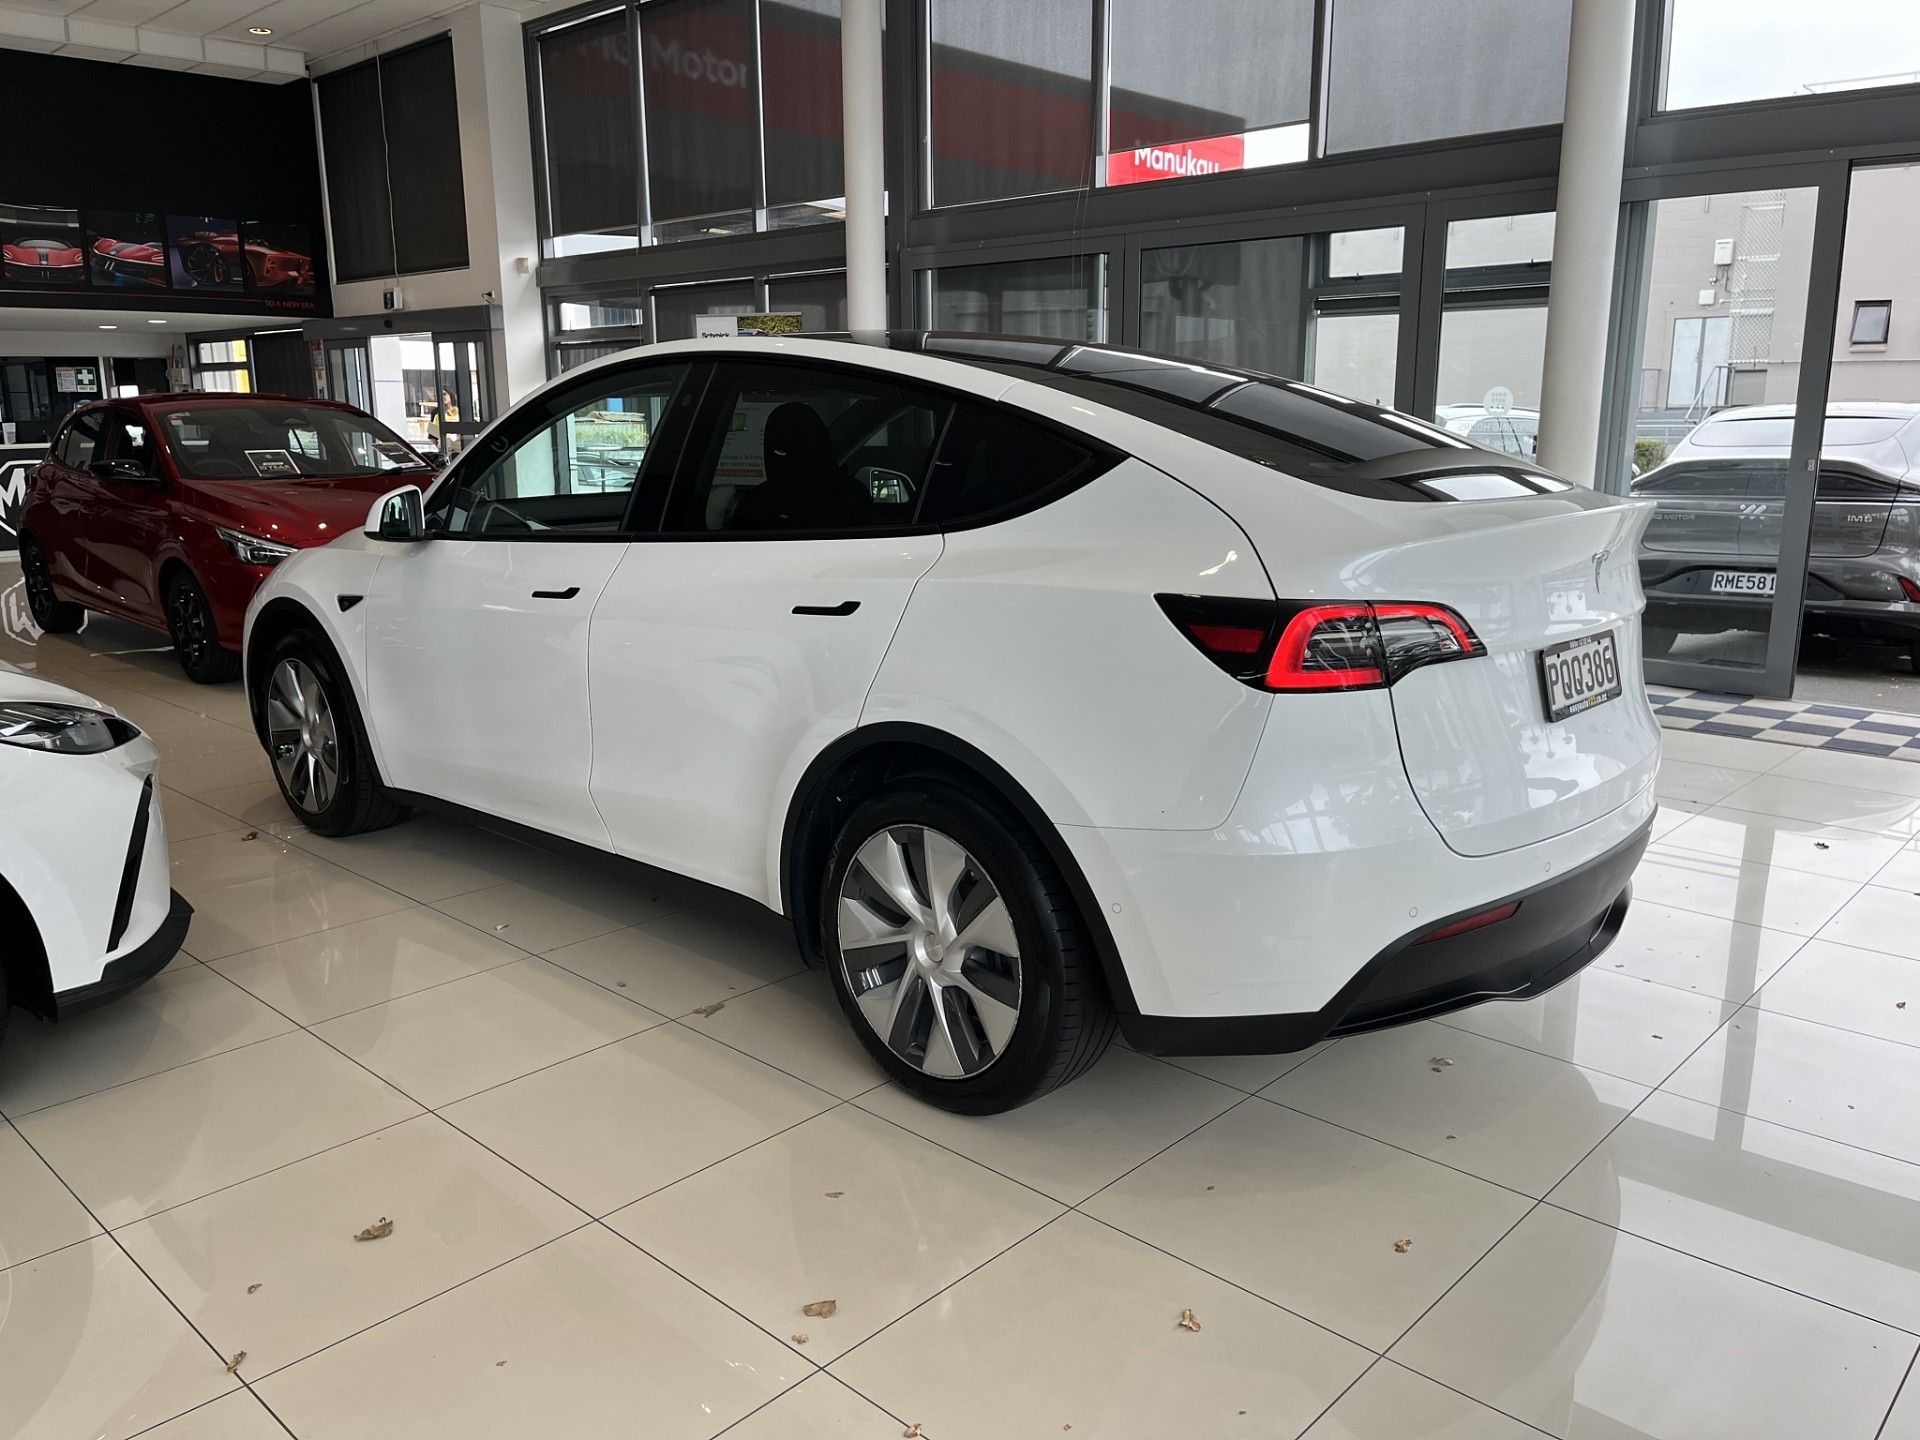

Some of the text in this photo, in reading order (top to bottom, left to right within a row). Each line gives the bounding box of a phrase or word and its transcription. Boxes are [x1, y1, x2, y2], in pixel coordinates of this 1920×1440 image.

[651, 36, 747, 89] Motor
[1134, 144, 1219, 176] Manukau
[1713, 574, 1776, 591] RME581
[1547, 643, 1615, 706] PQQ386
